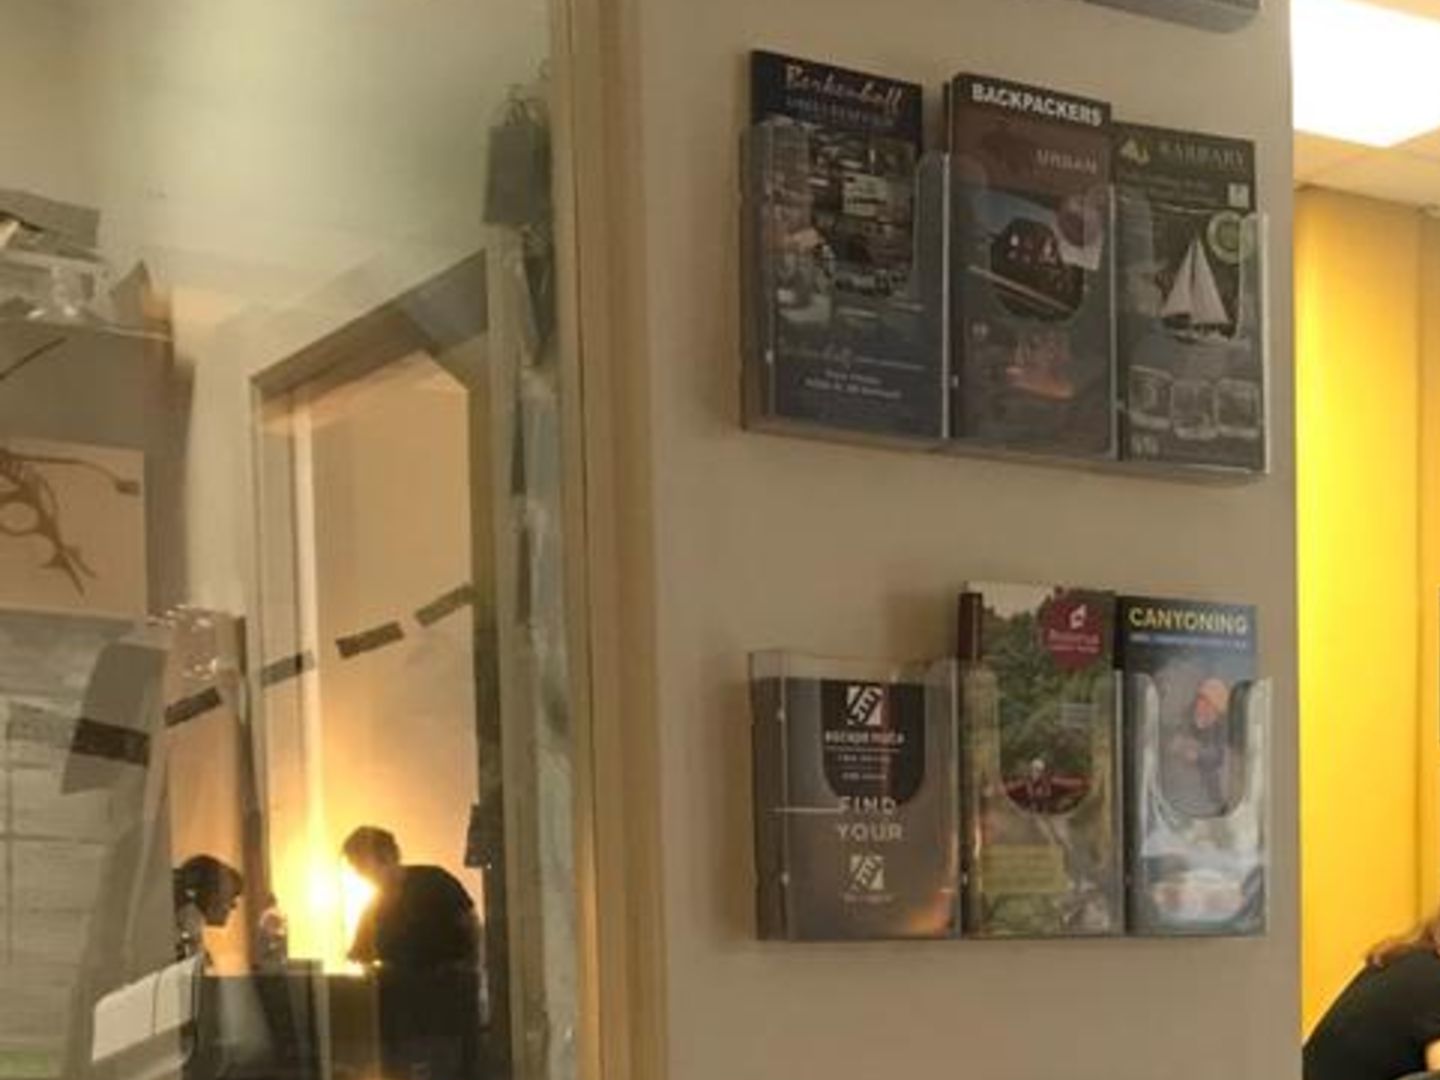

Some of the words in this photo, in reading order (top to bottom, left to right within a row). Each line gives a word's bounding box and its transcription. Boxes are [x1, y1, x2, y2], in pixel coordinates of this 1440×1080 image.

[971, 83, 1103, 127] BACKPACKERS
[1129, 607, 1248, 635] CANYONING
[839, 796, 898, 815] FIND
[838, 822, 902, 841] YOUR
